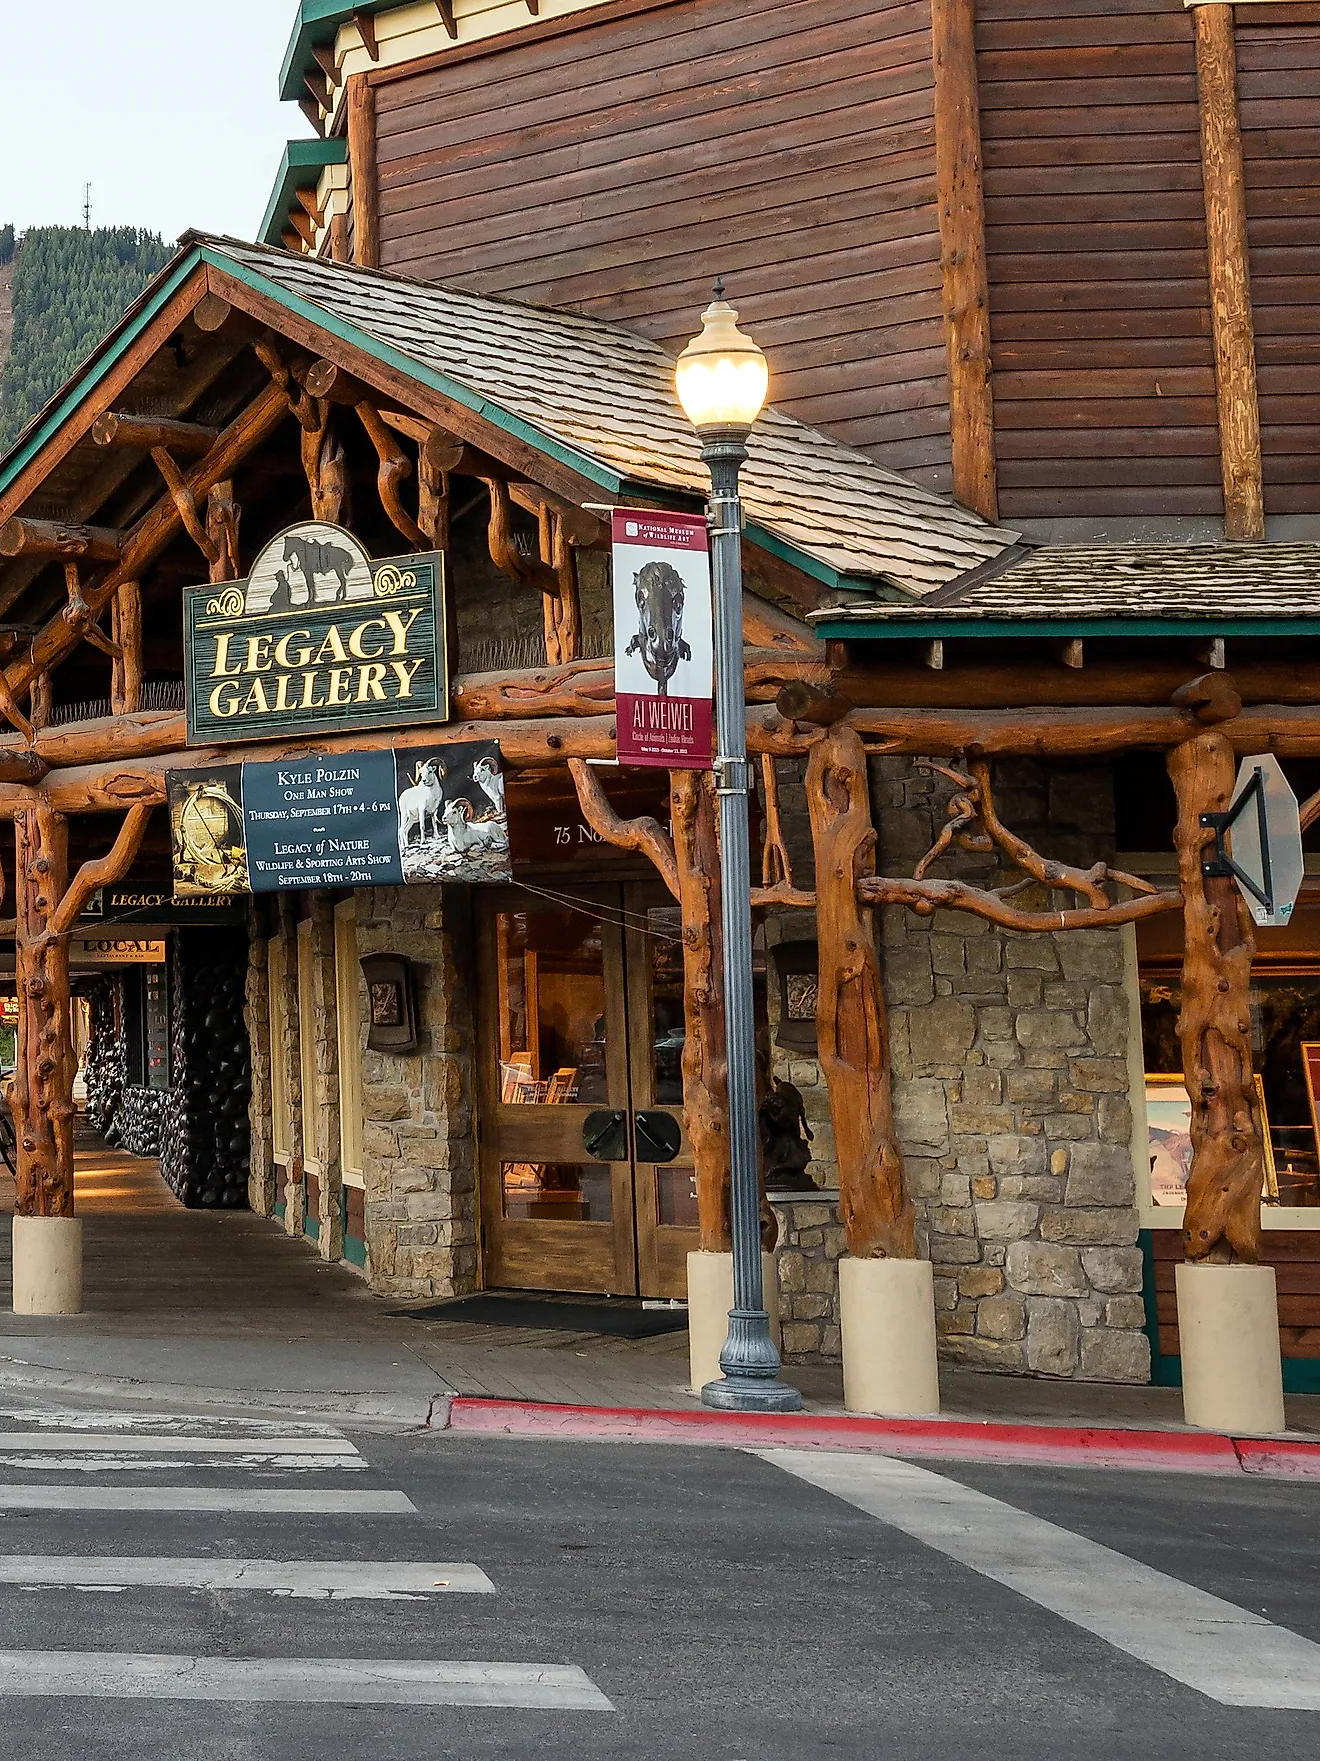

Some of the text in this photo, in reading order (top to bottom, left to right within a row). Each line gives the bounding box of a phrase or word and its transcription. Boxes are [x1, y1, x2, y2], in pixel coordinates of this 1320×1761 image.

[638, 523, 695, 536] NATIONAL MUSEUM
[649, 531, 676, 541] WILDLIFE
[209, 607, 424, 678] LEGACY
[208, 658, 425, 718] GALLERY
[633, 700, 693, 731] AI WEIWEI
[277, 768, 360, 786] KYLE POLZIN
[283, 786, 354, 801] ONE MAN SHOW
[249, 809, 289, 821] THURSDAY,
[290, 806, 331, 818] SEPTEMBER
[332, 804, 352, 815] 17TH
[379, 802, 391, 811] PM
[274, 838, 370, 856] LEGACY of NATURE
[255, 853, 392, 871] WILDLIFE & SPORTING ARTS SHOW
[278, 874, 322, 886] SEPTEMBER
[322, 871, 343, 883] 18TH
[350, 870, 372, 881] 20TH
[110, 894, 234, 907] LEGACY GALLERY
[83, 940, 160, 952] LOCAL
